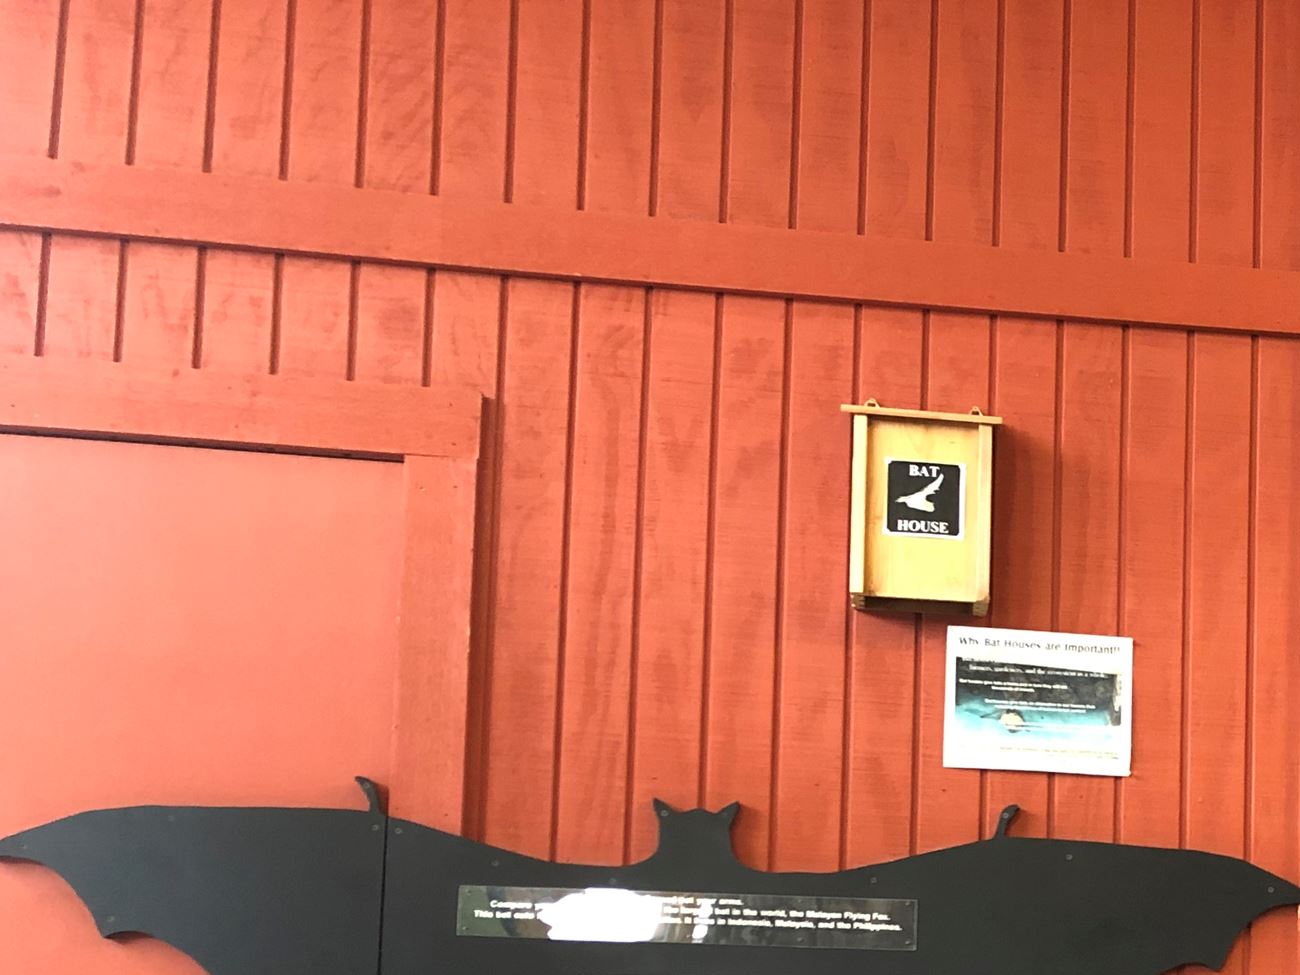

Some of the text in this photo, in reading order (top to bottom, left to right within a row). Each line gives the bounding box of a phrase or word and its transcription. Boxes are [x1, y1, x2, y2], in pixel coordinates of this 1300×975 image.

[909, 464, 940, 478] BAT
[897, 519, 949, 534] HOUSE
[959, 637, 979, 647] Why
[984, 638, 1000, 647] Bat
[1004, 639, 1041, 649] Houses
[1045, 642, 1061, 650] are
[844, 911, 871, 921] Flying
